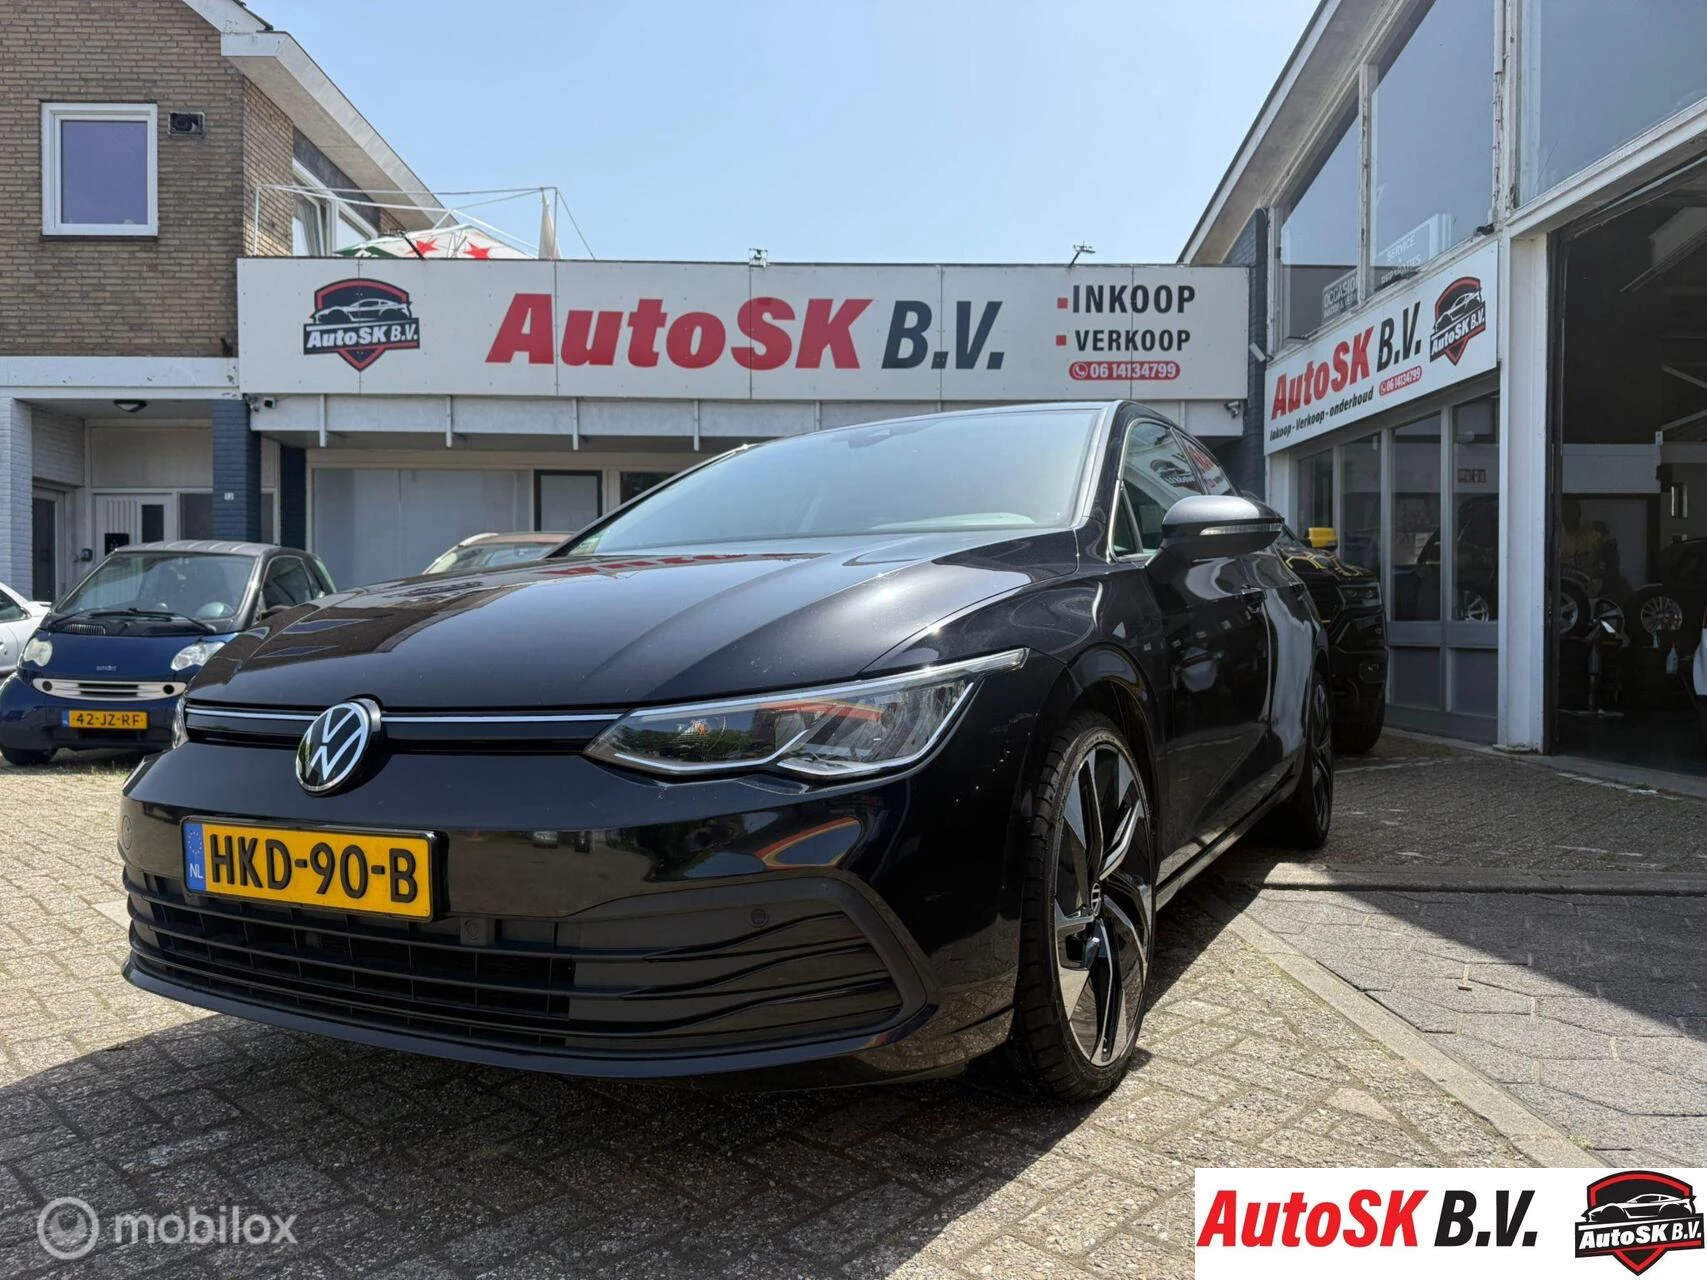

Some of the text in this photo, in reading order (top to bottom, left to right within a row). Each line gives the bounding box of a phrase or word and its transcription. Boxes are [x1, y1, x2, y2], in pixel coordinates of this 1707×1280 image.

[1072, 284, 1195, 314] INKOOP
[306, 323, 418, 348] AutoSK B.V.
[484, 293, 1005, 371] AutoSK B.V.
[1074, 329, 1191, 352] VERKOOP
[1431, 308, 1486, 356] AutoSK B.V.
[1089, 363, 1177, 379] 06 14134799
[1271, 301, 1422, 421] AutoSK B.V.
[1295, 410, 1325, 431] Verkoop
[1329, 386, 1375, 417] onderhoud
[76, 713, 141, 727] 42-JZ-RF
[189, 863, 204, 880] NL
[209, 833, 419, 905] HKD-90-B
